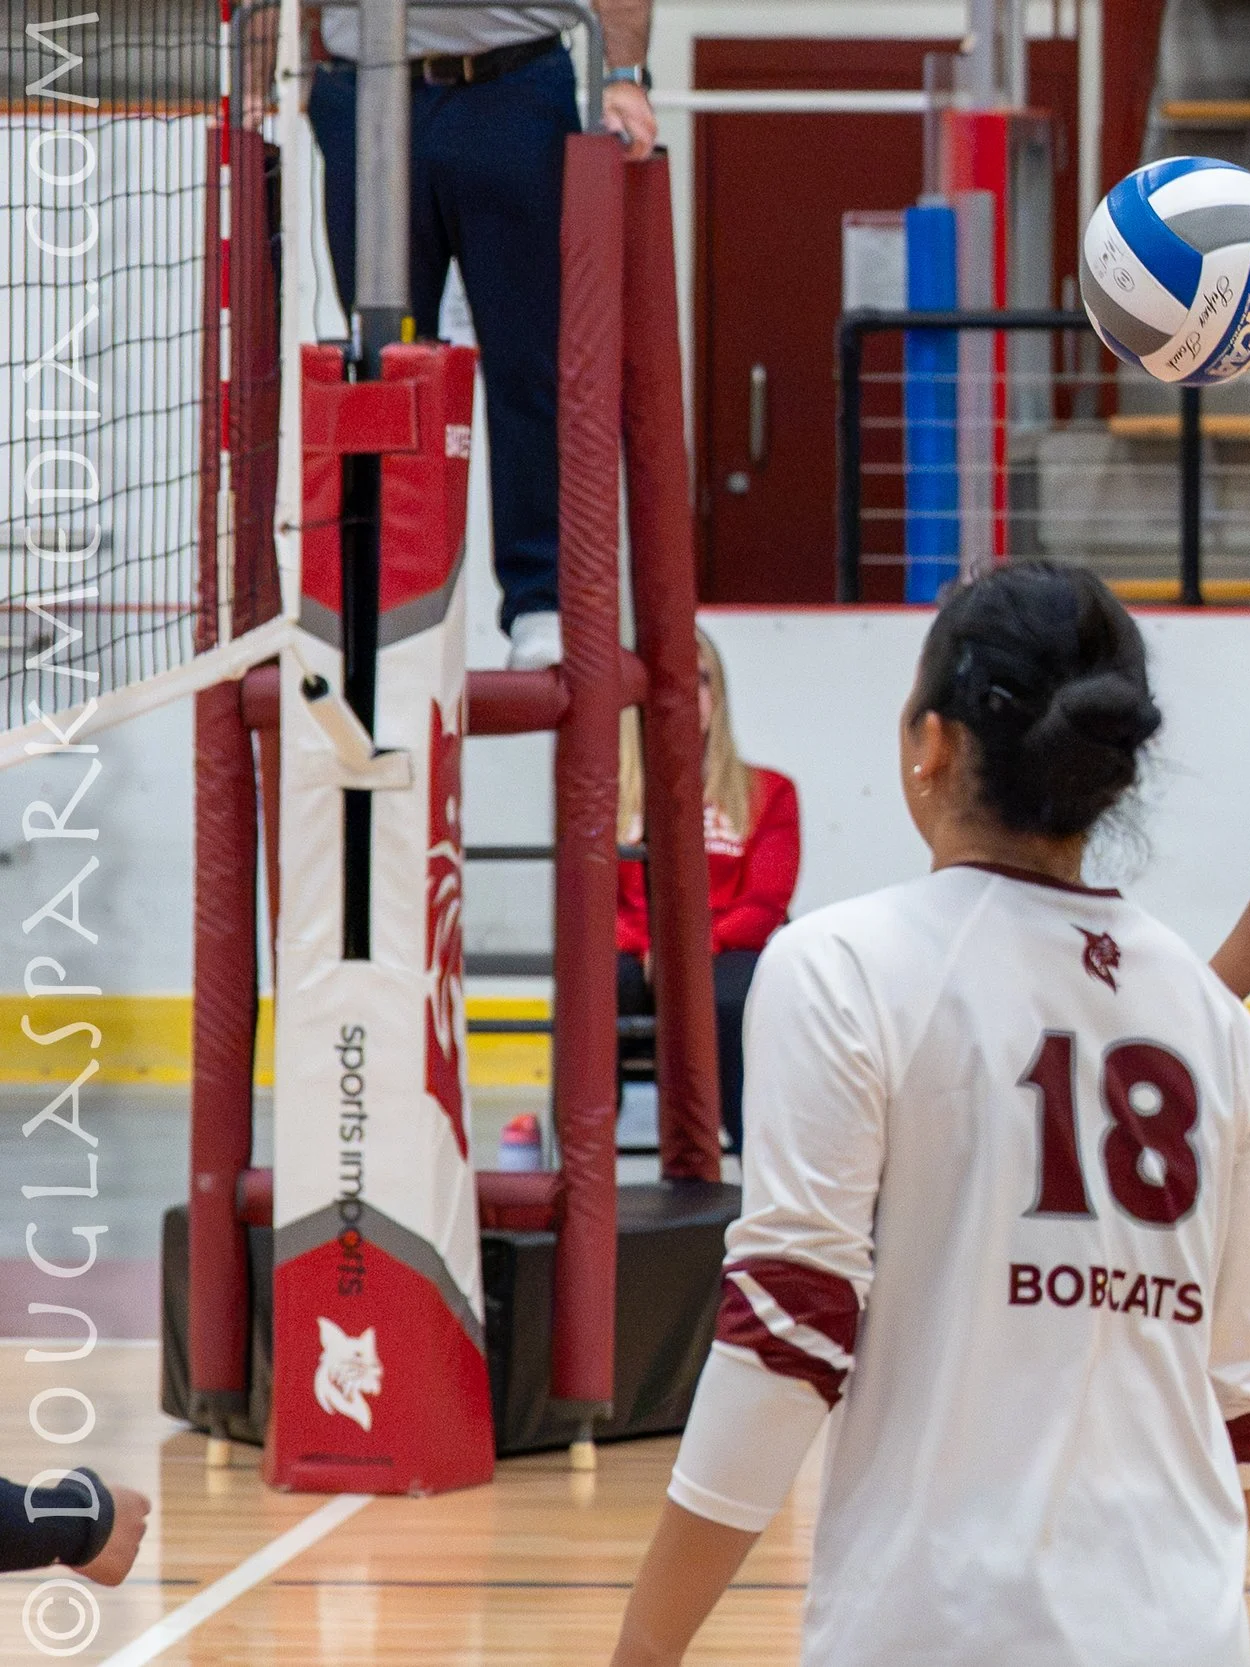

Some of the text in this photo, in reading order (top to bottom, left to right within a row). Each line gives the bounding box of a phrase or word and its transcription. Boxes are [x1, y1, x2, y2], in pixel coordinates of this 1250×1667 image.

[1165, 275, 1234, 371] Super Touch
[335, 1024, 368, 1297] sports imports
[1017, 1029, 1202, 1230] 18
[1009, 1264, 1204, 1325] BOBCATS
